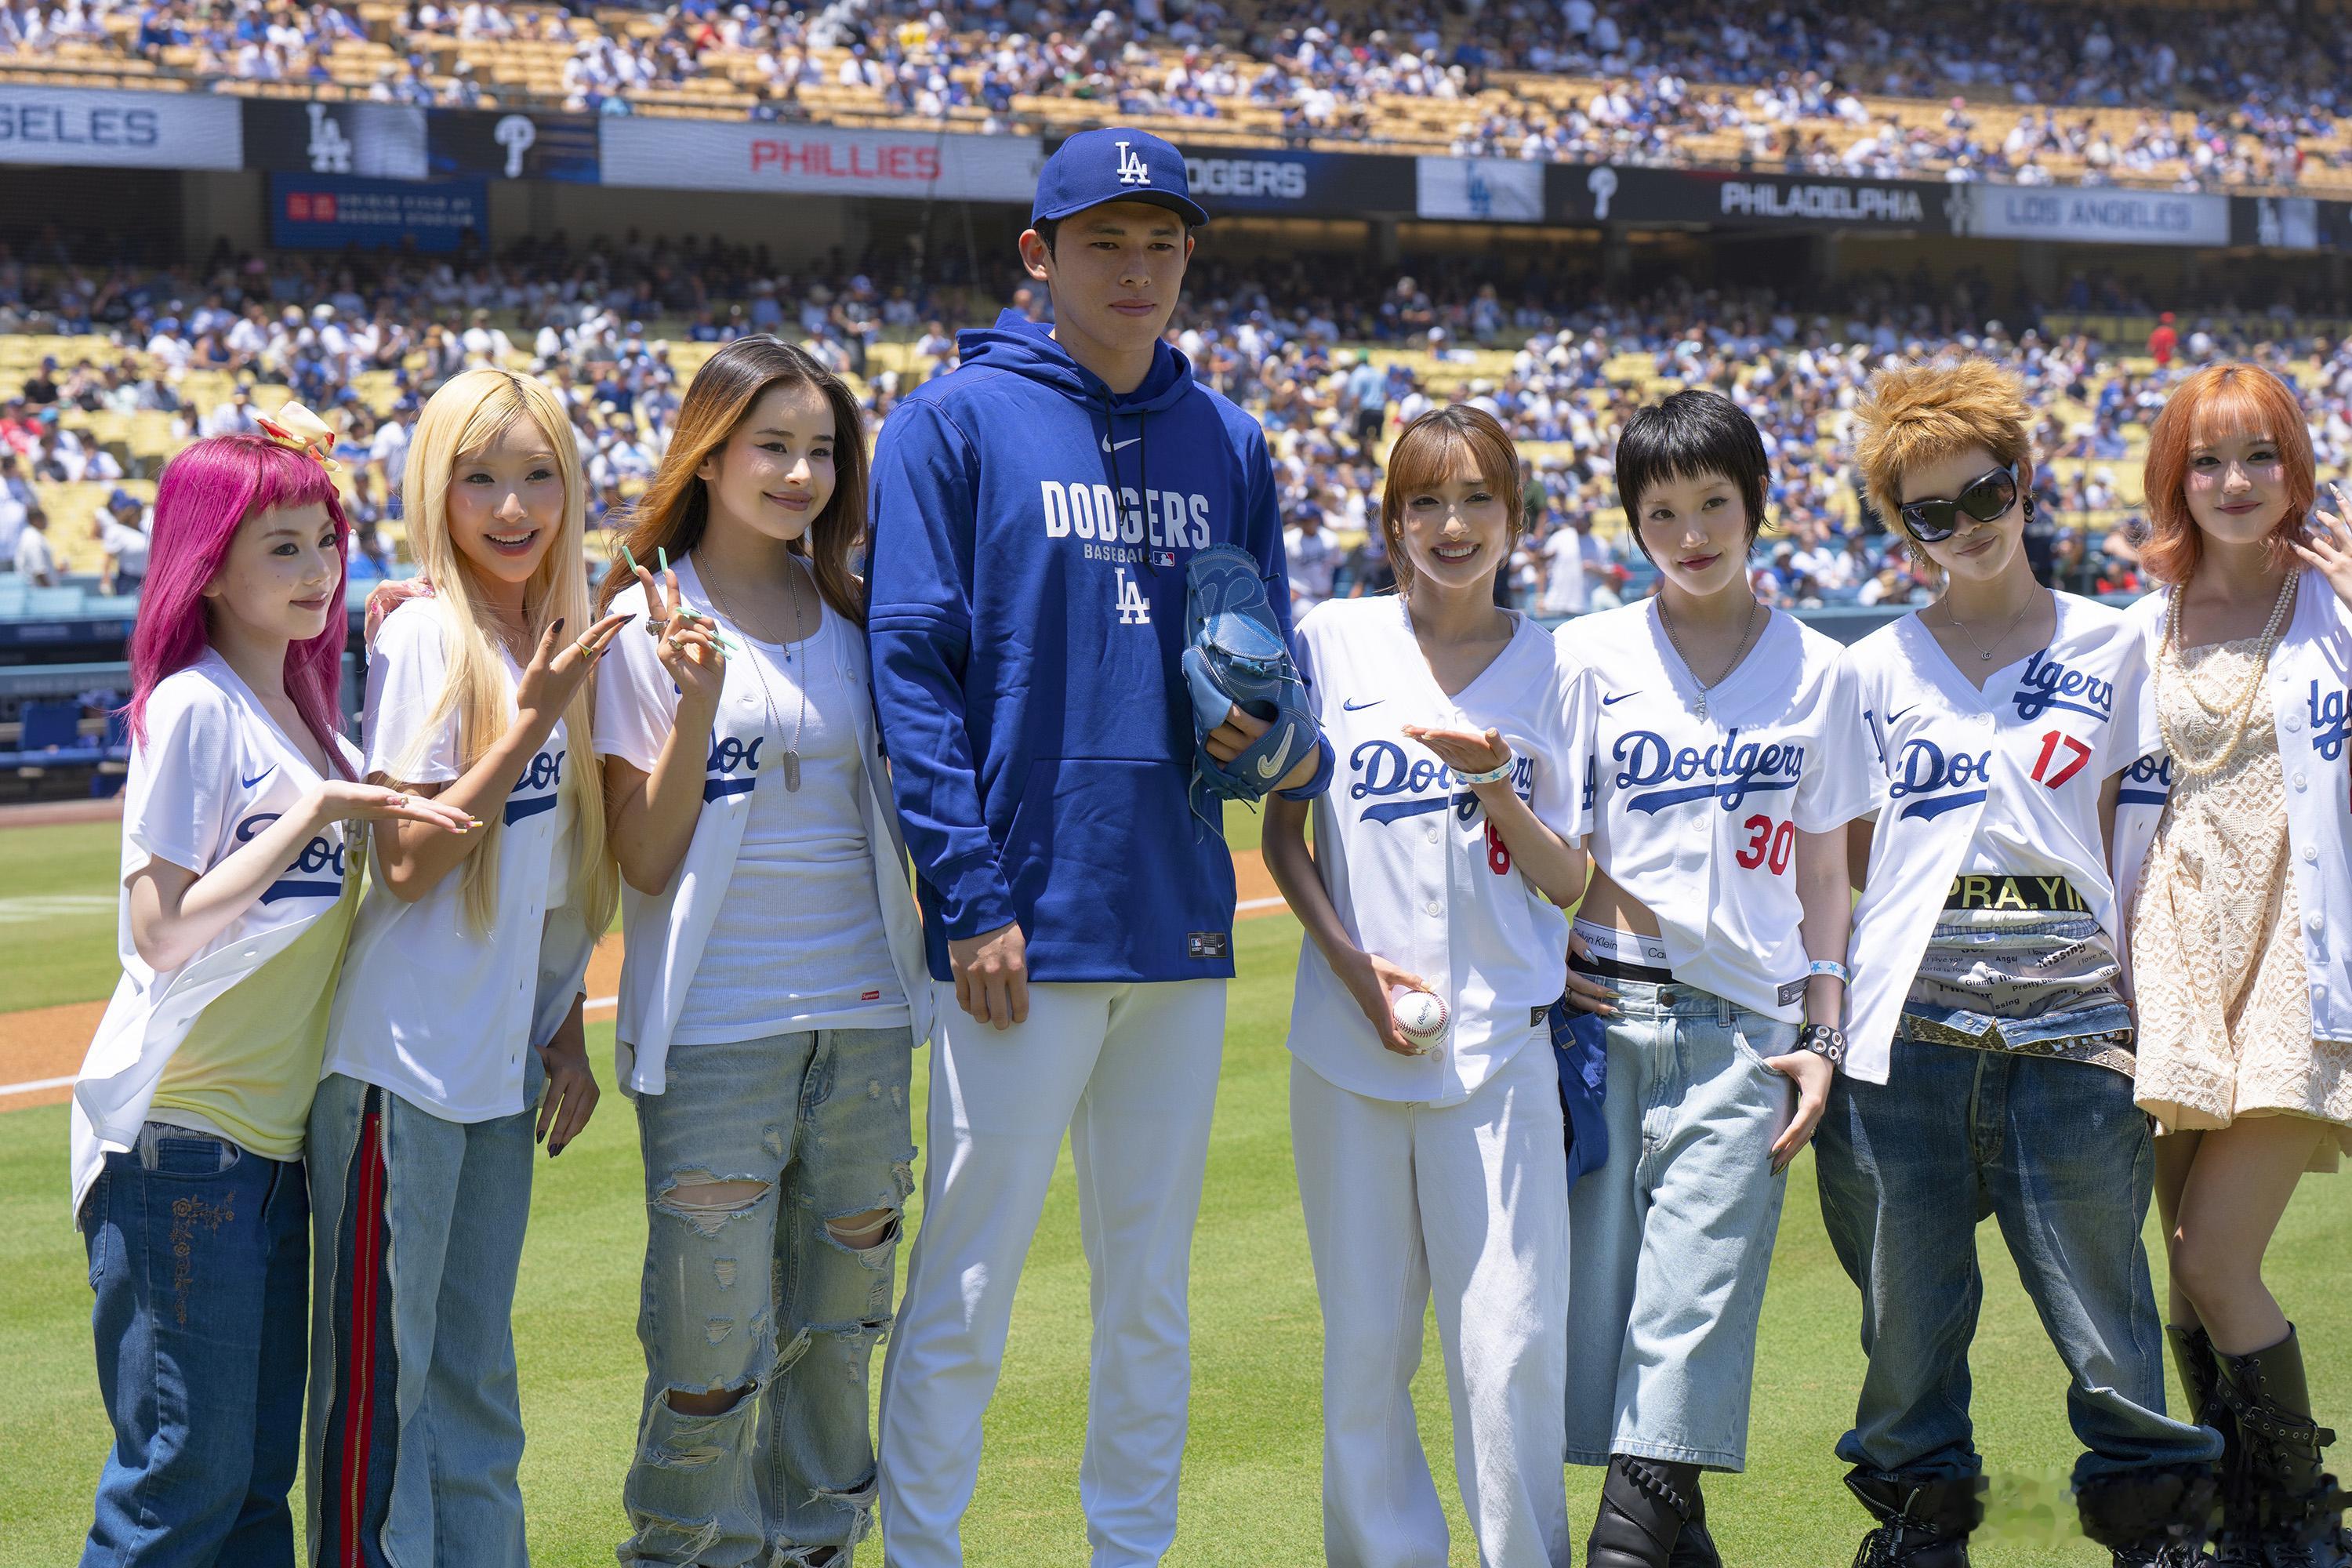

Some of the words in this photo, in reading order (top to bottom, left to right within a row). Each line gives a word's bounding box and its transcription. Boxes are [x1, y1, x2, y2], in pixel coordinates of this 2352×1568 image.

[750, 139, 943, 180] PHILLIES
[1115, 141, 1150, 185] LA
[1721, 182, 1924, 221] PHILADELPHIA
[2005, 196, 2060, 226] LOS
[2068, 200, 2193, 231] ANGELES
[1040, 481, 1210, 550] DODGERS
[1114, 567, 1151, 624] LA
[1613, 728, 1805, 814] Dodgers
[2031, 730, 2092, 789] 17
[1736, 814, 1794, 876] 30
[1948, 876, 2085, 910] RA.YI
[1573, 928, 1594, 944] lvin
[1595, 935, 1618, 950] Klein
[1995, 954, 2018, 964] Angel
